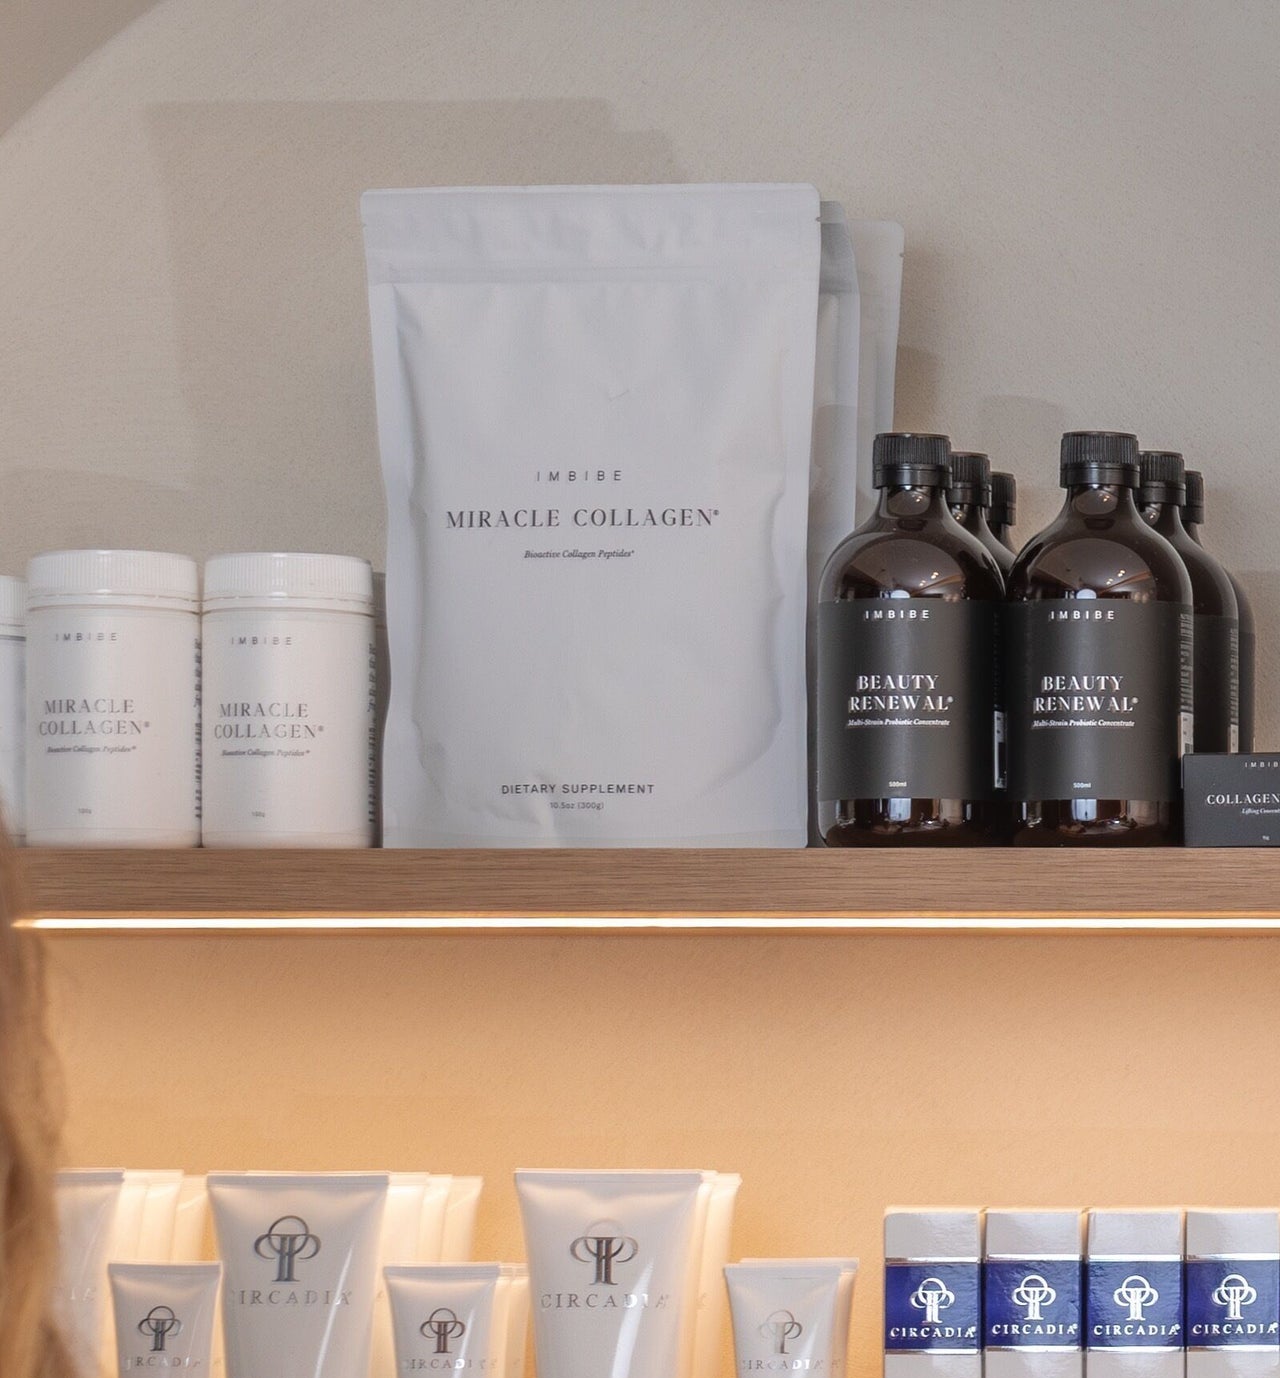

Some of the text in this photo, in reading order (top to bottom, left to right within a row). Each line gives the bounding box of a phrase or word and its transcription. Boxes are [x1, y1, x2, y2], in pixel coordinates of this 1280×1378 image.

[536, 470, 624, 482] IMBIBE
[445, 509, 561, 529] MIRACLE
[524, 549, 596, 560] Bioactive Collagen
[865, 610, 931, 621] IMBIBE
[1050, 611, 1115, 622] IMBIBE
[857, 675, 939, 691] BEAUTY
[1042, 675, 1124, 692] BEAUTY
[44, 699, 134, 714] MIRACLE
[219, 702, 309, 718] MIRACLE
[501, 782, 655, 796] DIETARY SUPPLEMENT
[1207, 793, 1280, 804] COLLAGEN
